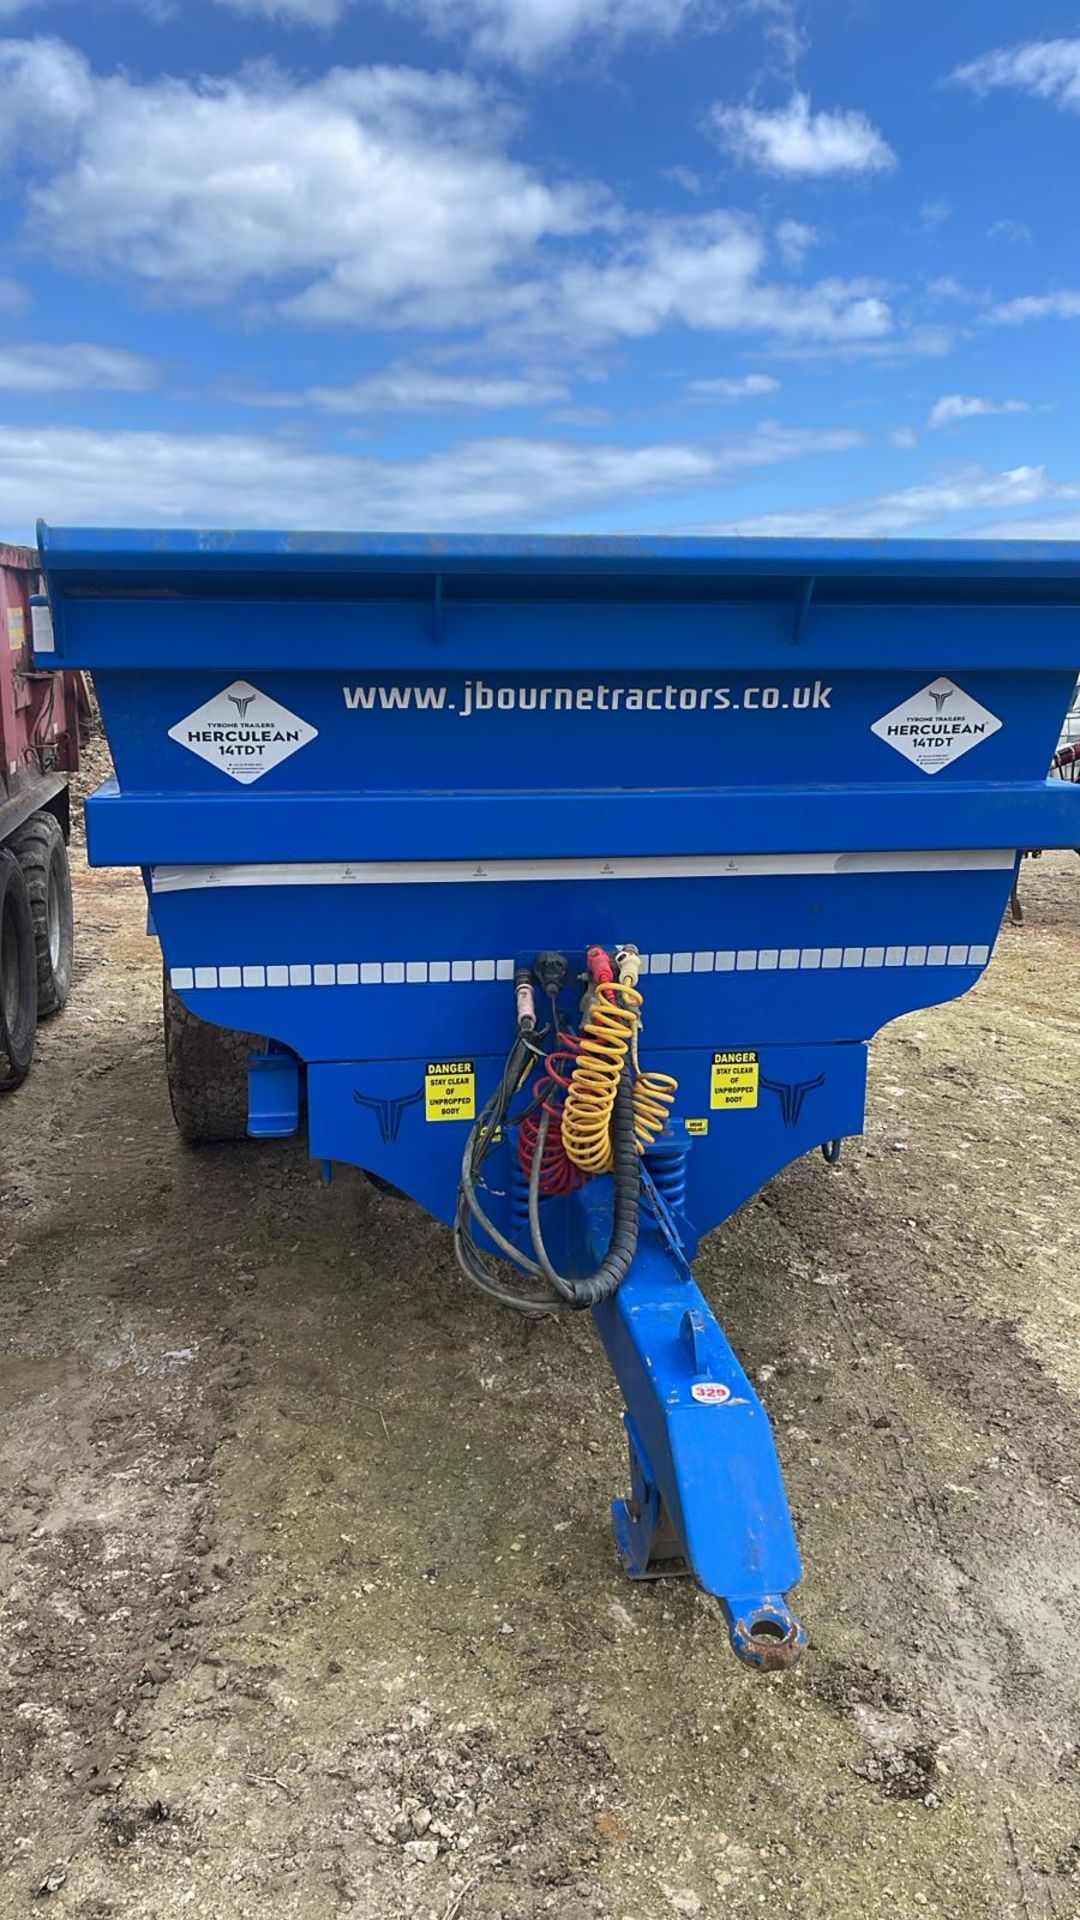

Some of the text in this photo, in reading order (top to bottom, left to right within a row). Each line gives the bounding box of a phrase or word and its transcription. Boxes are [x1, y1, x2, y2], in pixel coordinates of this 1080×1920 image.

[343, 681, 833, 716] www.jbournetractors.co.uk
[887, 723, 985, 736] HERCULEAN
[188, 731, 299, 742] HERCULEAN
[912, 737, 954, 748] 14TDT
[218, 745, 265, 755] 14TDT
[714, 1052, 756, 1063] DANGER
[428, 1063, 471, 1074] DANGER
[714, 1086, 754, 1094] UNPROPPED
[429, 1097, 471, 1106] UNPROPPED
[695, 1388, 727, 1397] 329
